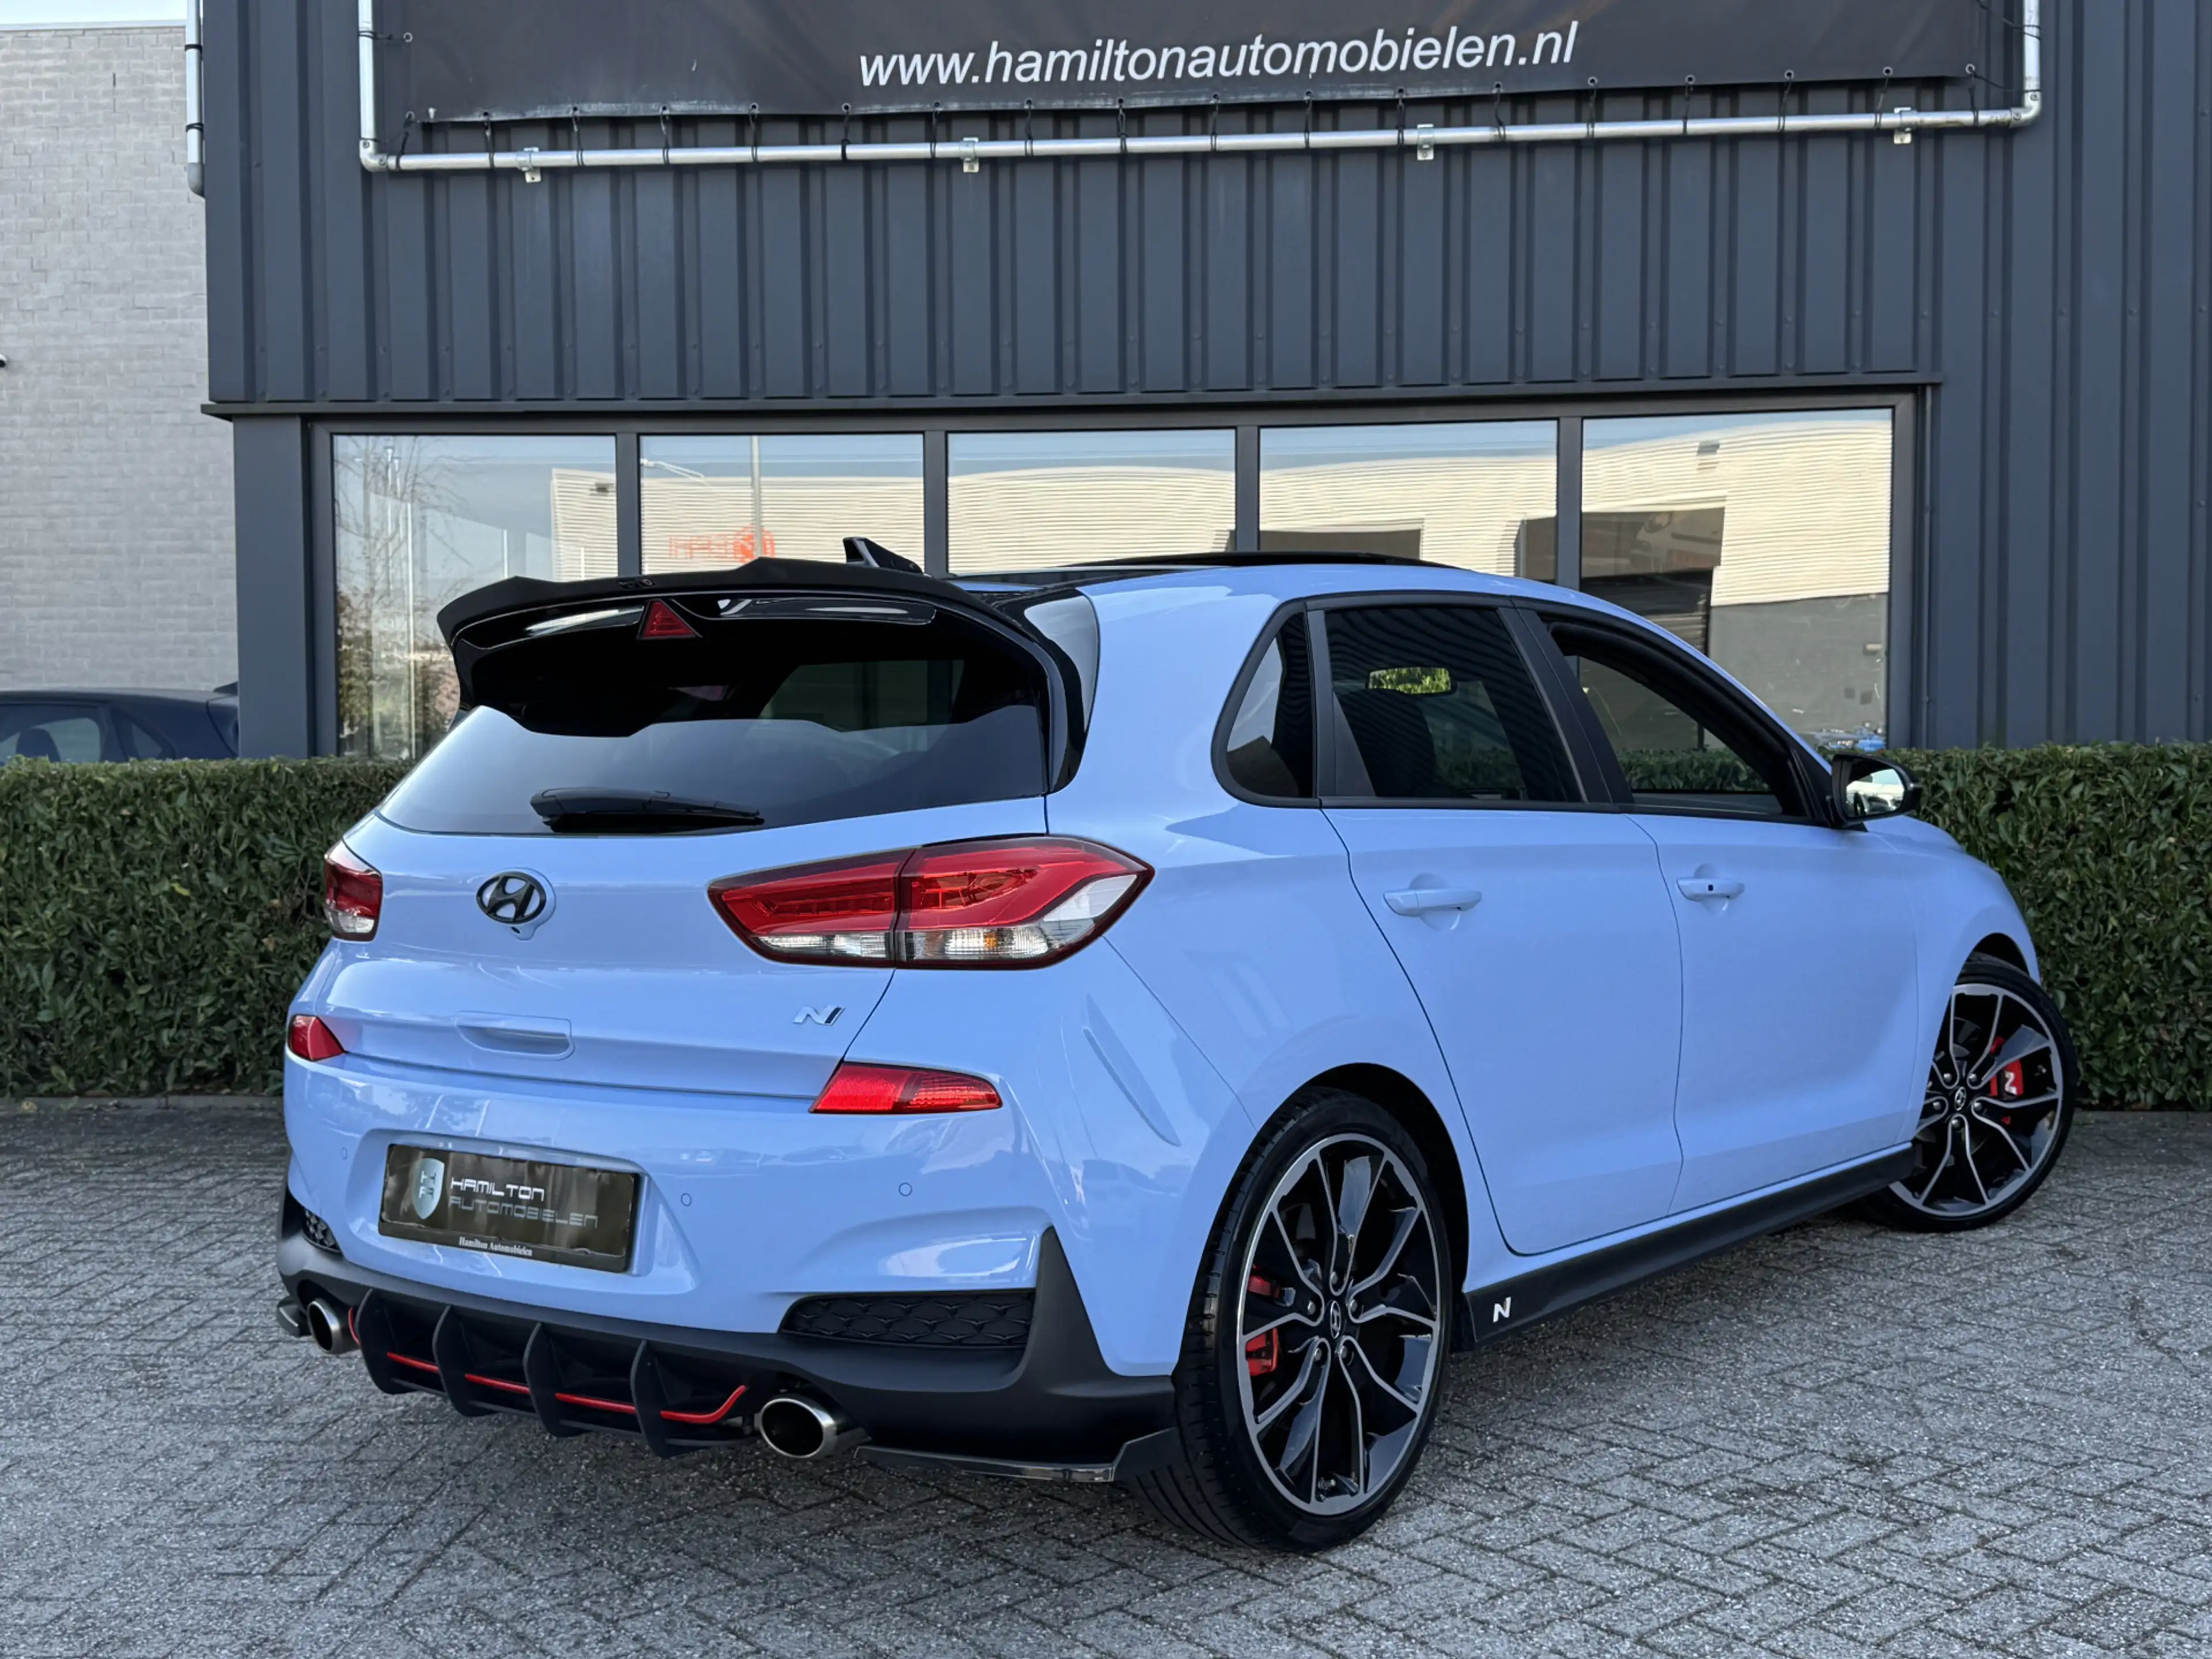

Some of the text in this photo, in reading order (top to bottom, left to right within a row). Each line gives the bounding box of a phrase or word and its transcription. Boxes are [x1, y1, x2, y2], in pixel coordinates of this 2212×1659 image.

[859, 21, 1579, 87] www.hamiltonautomobielen.nl
[793, 1005, 845, 1026] N
[450, 1177, 544, 1202] HAMILTON
[448, 1195, 598, 1228] AUTOMOBIELEN
[459, 1236, 533, 1256] Hamilton Automobielen
[1493, 1297, 1511, 1323] N
